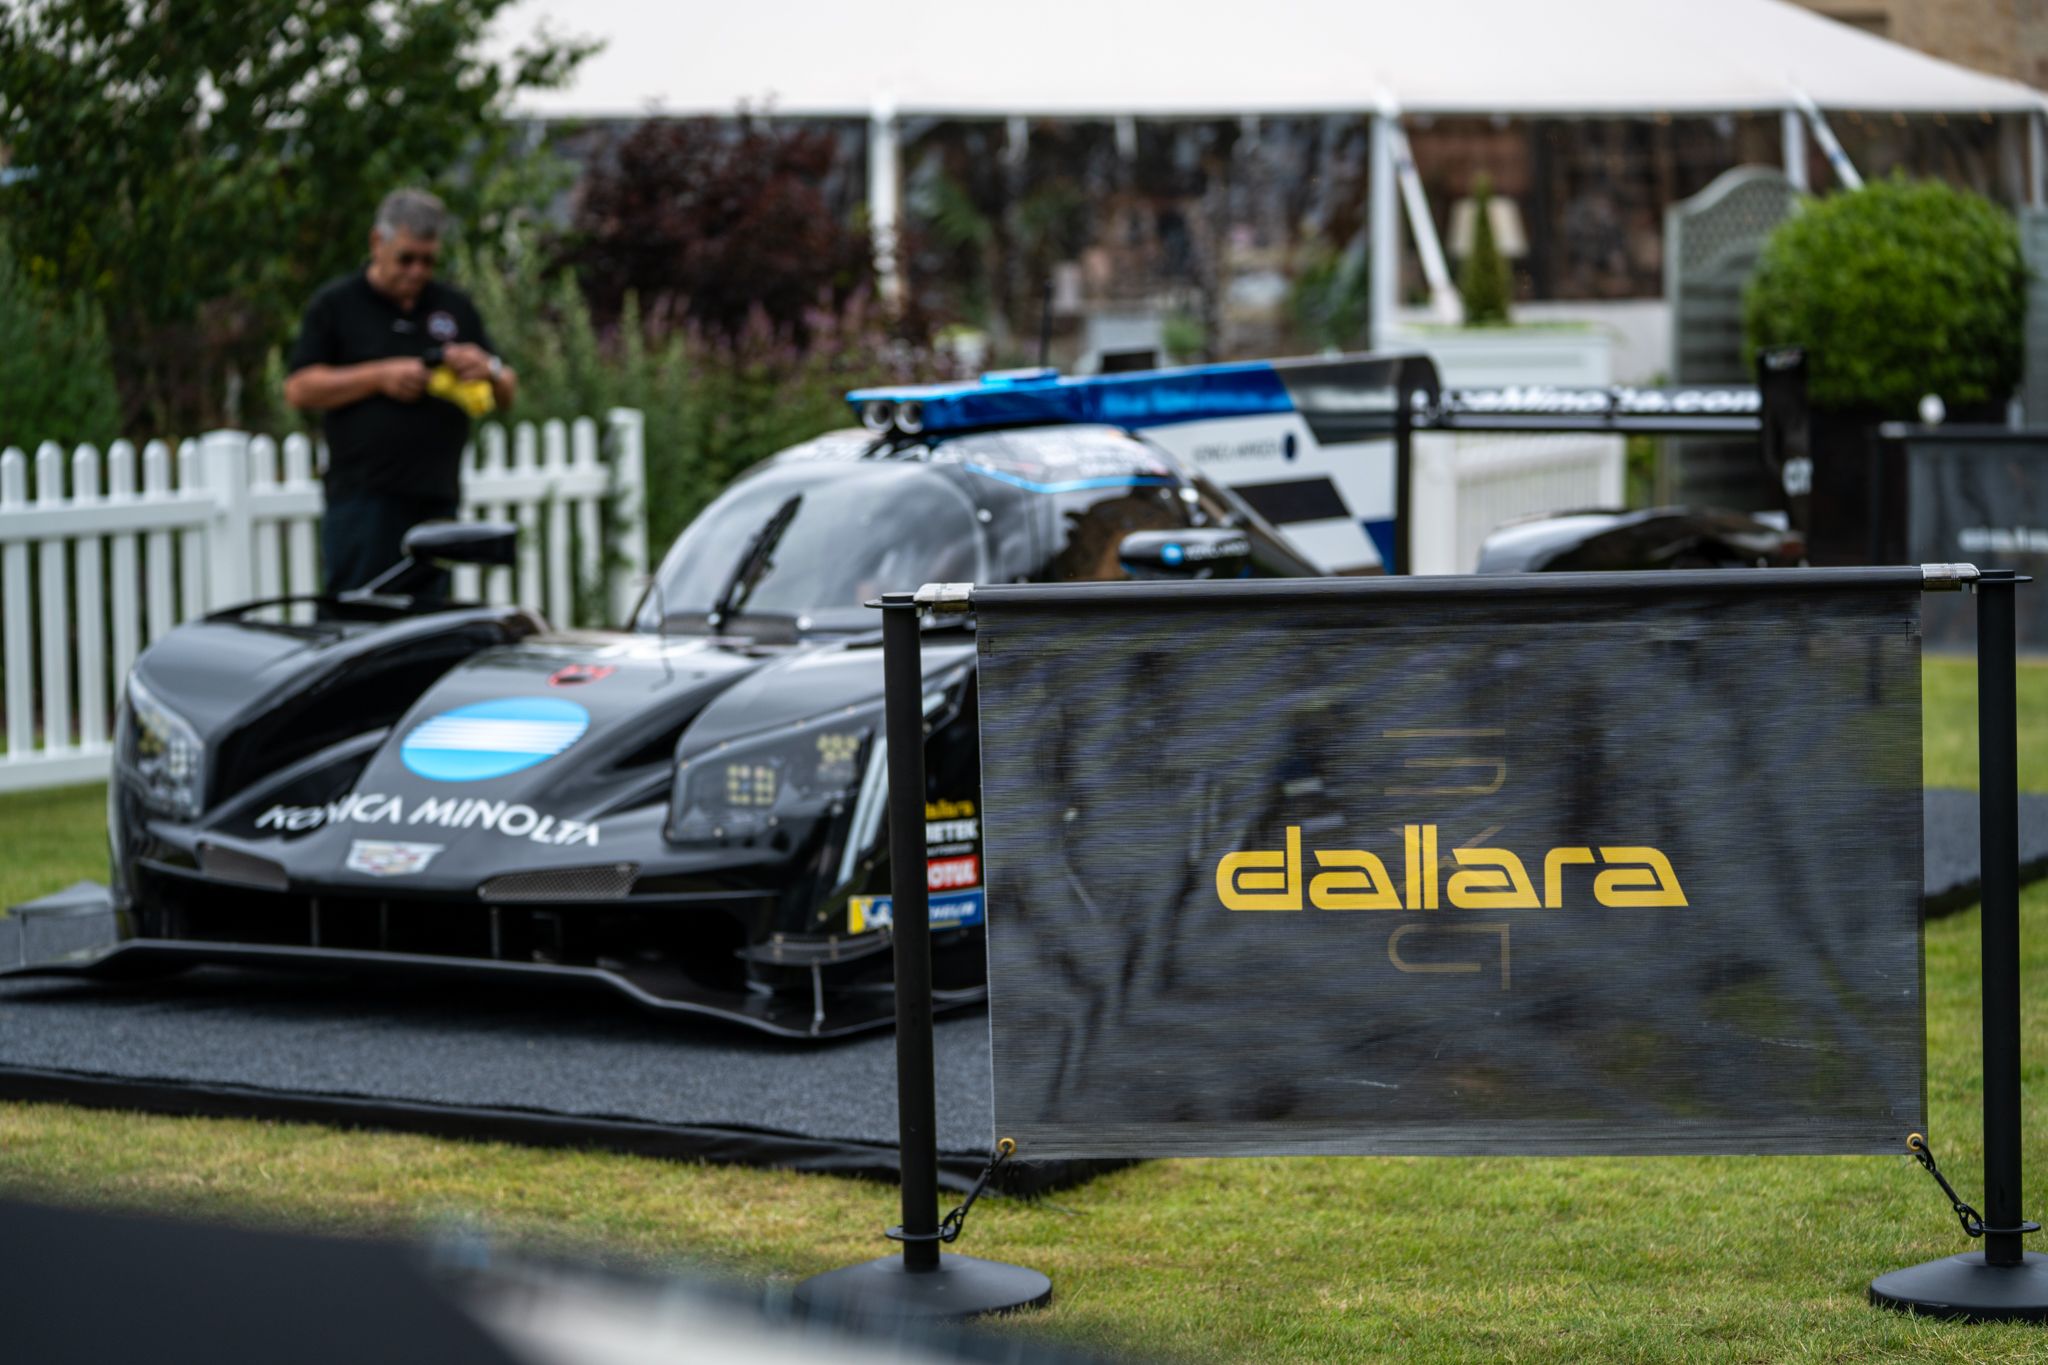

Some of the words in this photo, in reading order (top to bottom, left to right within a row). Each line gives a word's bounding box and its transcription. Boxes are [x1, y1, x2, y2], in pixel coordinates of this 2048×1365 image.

[254, 793, 403, 831] KONICA
[408, 796, 600, 847] MINOLTA
[928, 861, 976, 887] OTUL
[1215, 823, 1690, 911] dallara
